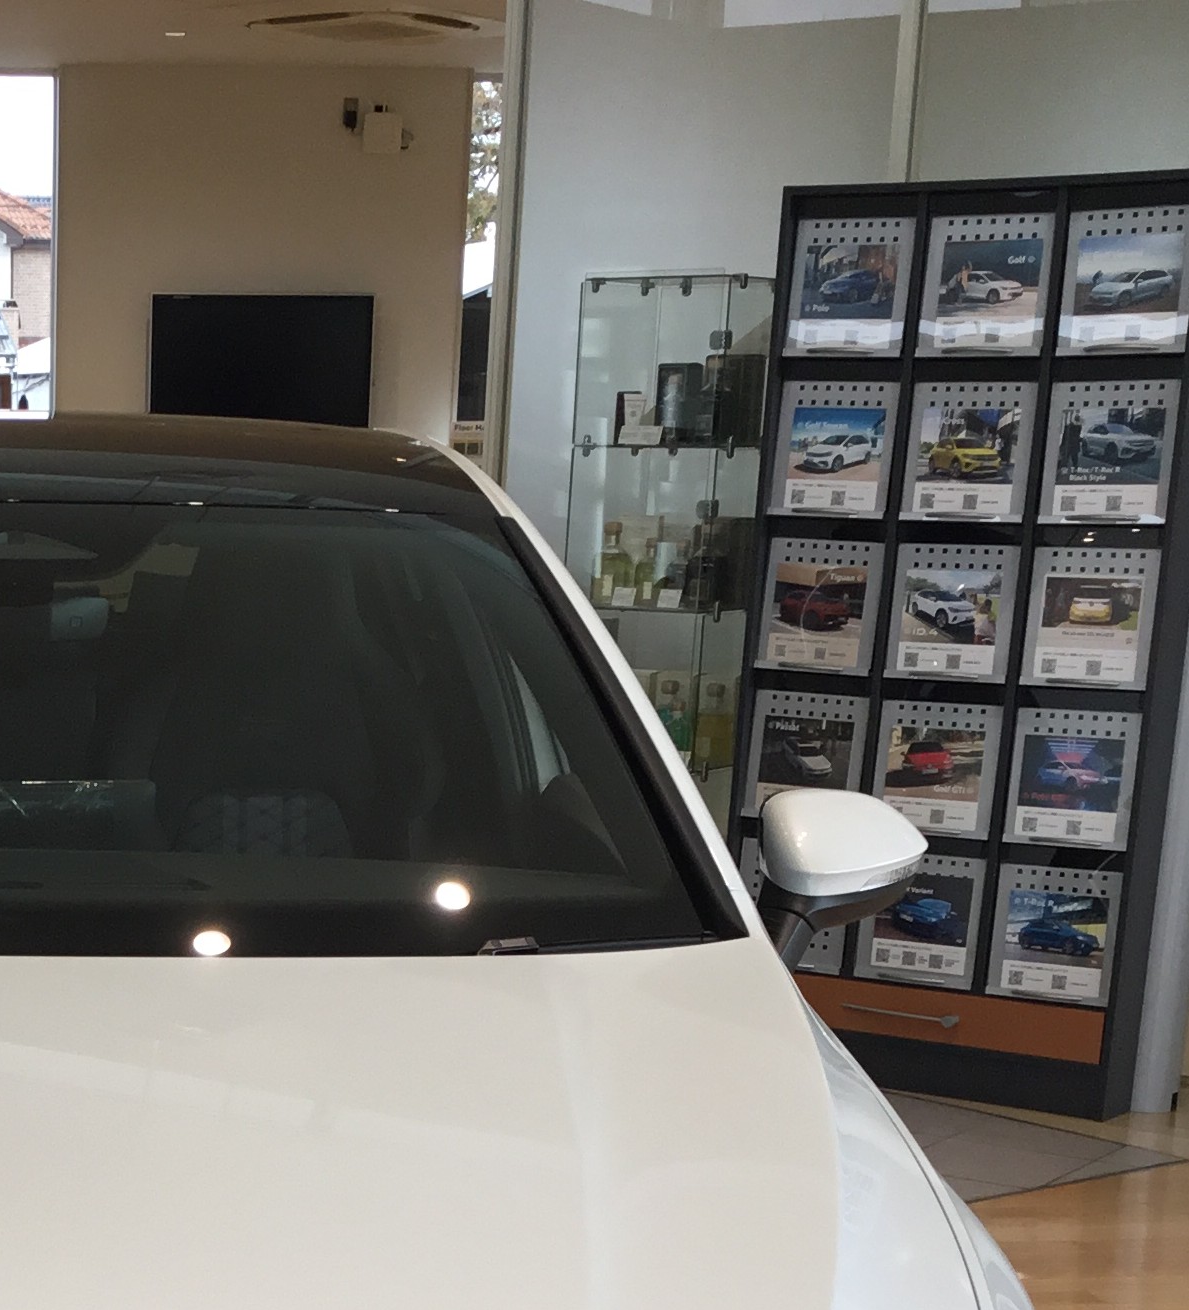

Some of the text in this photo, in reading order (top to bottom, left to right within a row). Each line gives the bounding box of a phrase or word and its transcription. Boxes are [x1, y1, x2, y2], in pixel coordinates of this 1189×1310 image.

[1007, 255, 1026, 265] Golf
[812, 303, 830, 313] Polo
[829, 573, 856, 583] Tiguan
[933, 784, 966, 795] Golf GTI
[911, 886, 934, 896] Variant
